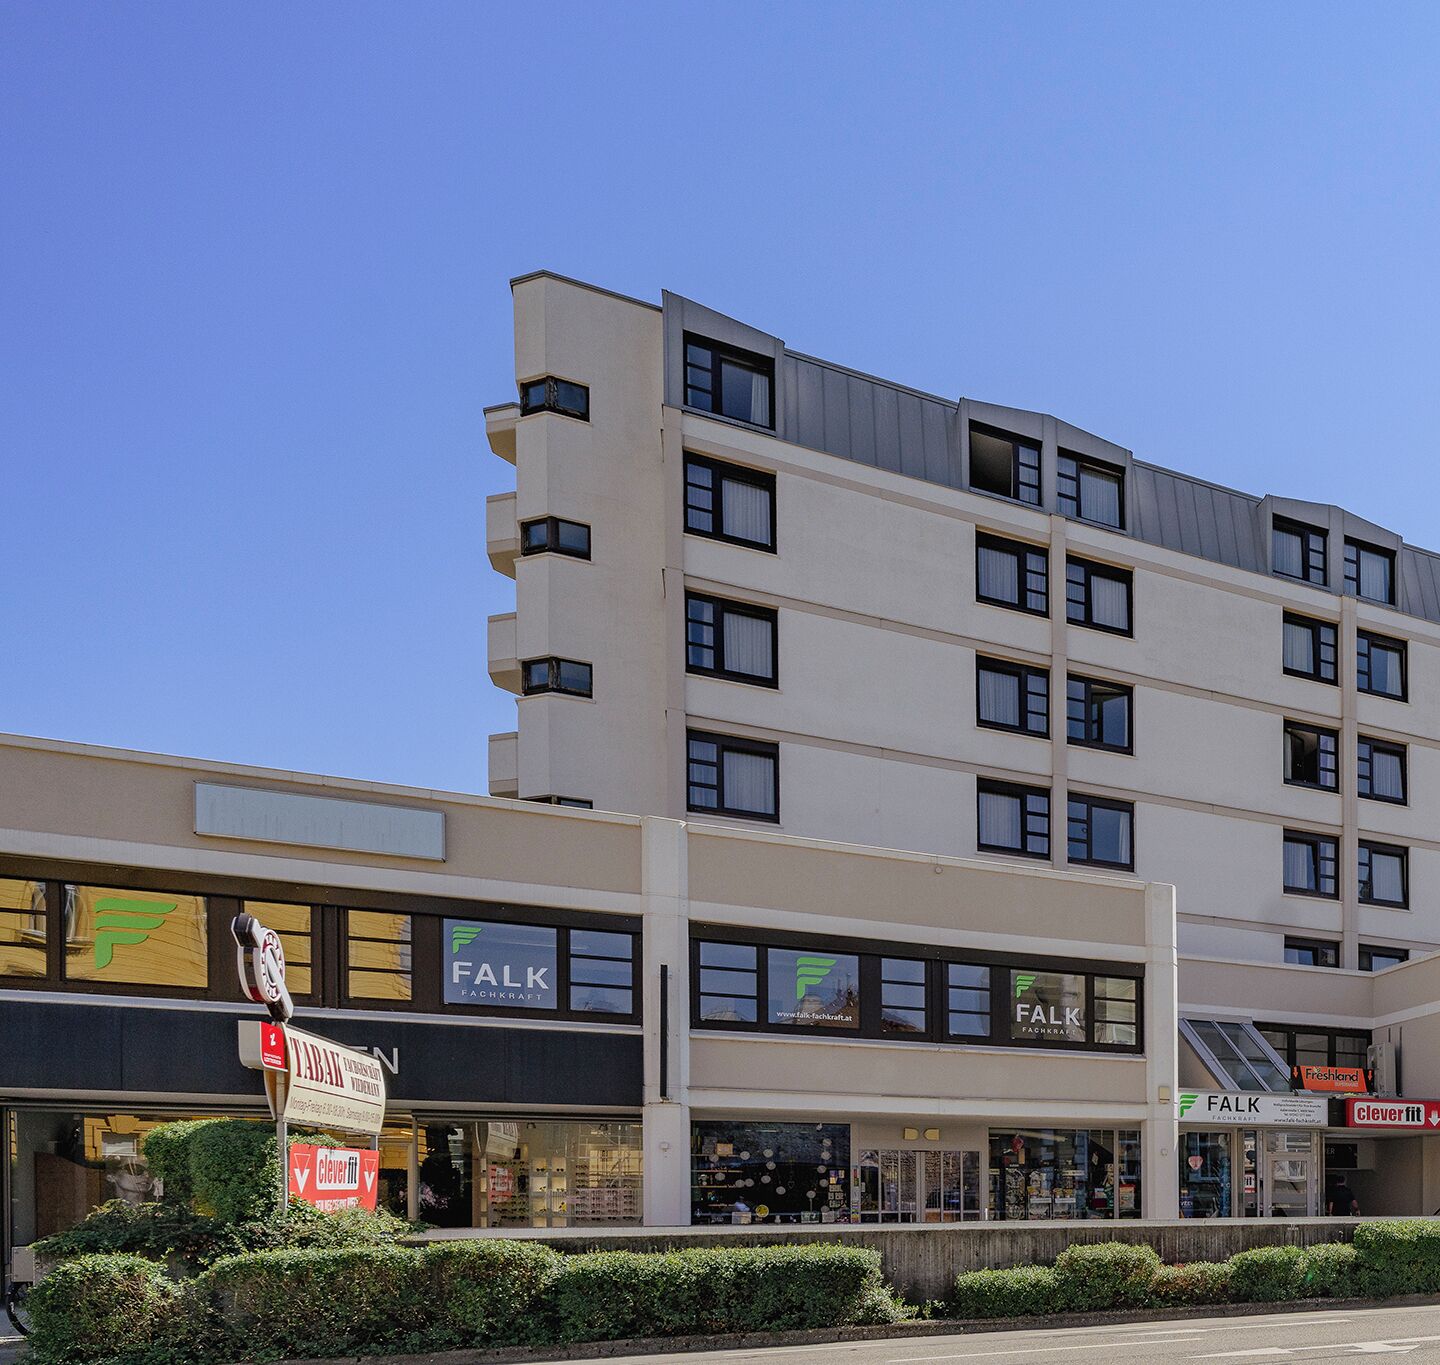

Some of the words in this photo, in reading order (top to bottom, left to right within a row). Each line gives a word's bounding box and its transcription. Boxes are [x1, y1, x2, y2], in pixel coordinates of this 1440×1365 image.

[452, 961, 549, 989] FALK
[461, 989, 541, 1001] FACHKRAFT
[776, 1011, 853, 1022] www.falk-fachkraft.at
[1016, 1004, 1080, 1026] FALK
[1022, 1026, 1076, 1035] FACHKRAFT
[289, 1036, 344, 1089] TABAK
[1305, 1067, 1359, 1082] Freshland
[1207, 1095, 1260, 1113] FALK
